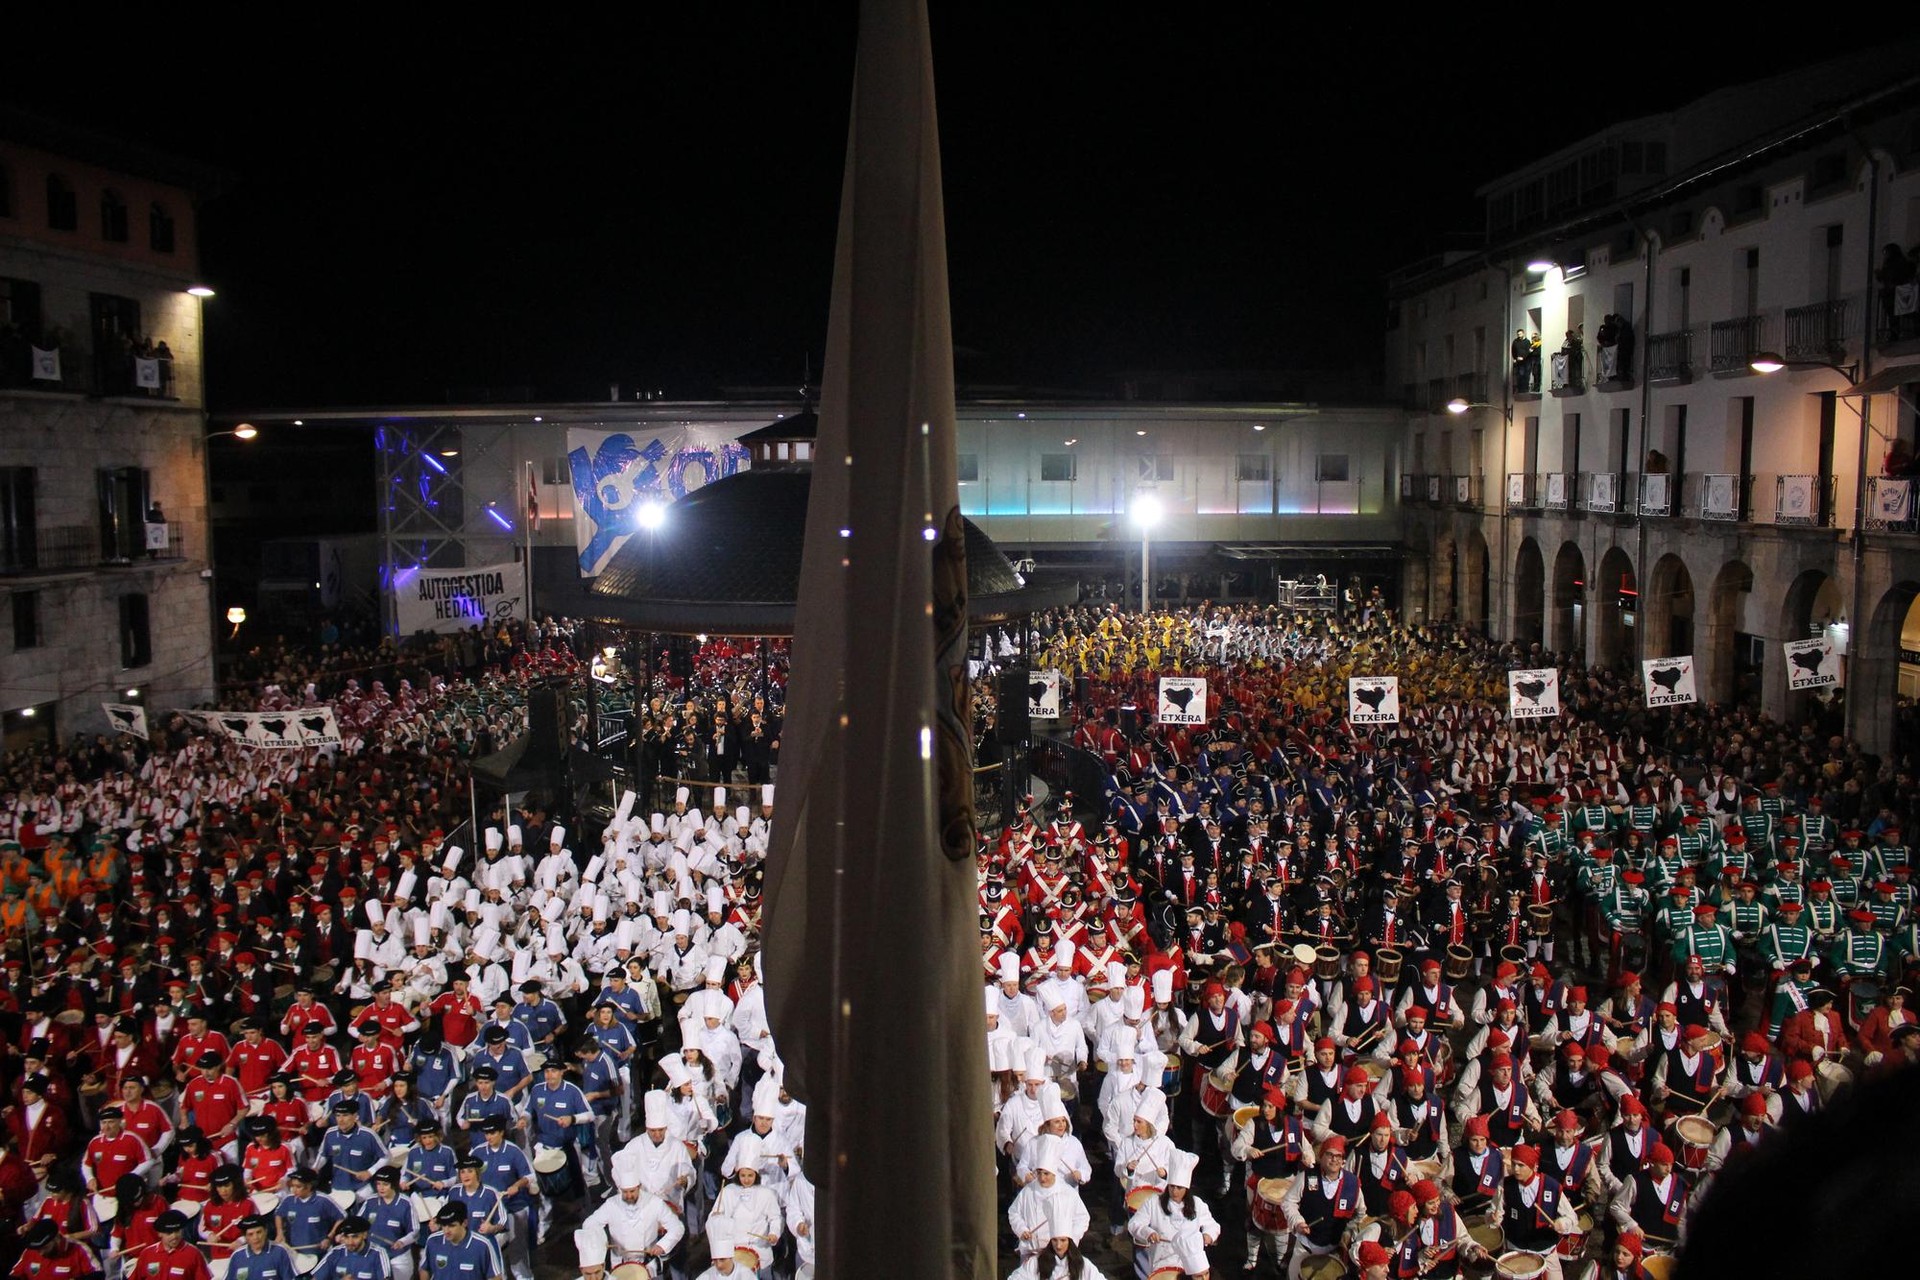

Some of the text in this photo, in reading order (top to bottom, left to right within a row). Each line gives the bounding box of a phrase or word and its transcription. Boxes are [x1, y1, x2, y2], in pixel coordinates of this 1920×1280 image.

[419, 572, 504, 600] AUTOGESTIOA
[1792, 674, 1836, 688] ETXERA
[1650, 693, 1692, 704] ETXERA
[1029, 707, 1056, 715] XERA
[1514, 706, 1556, 716] ETXERA
[1161, 714, 1202, 722] ETXERA
[1353, 713, 1397, 721] ETXERA
[306, 736, 340, 745] ETXERA
